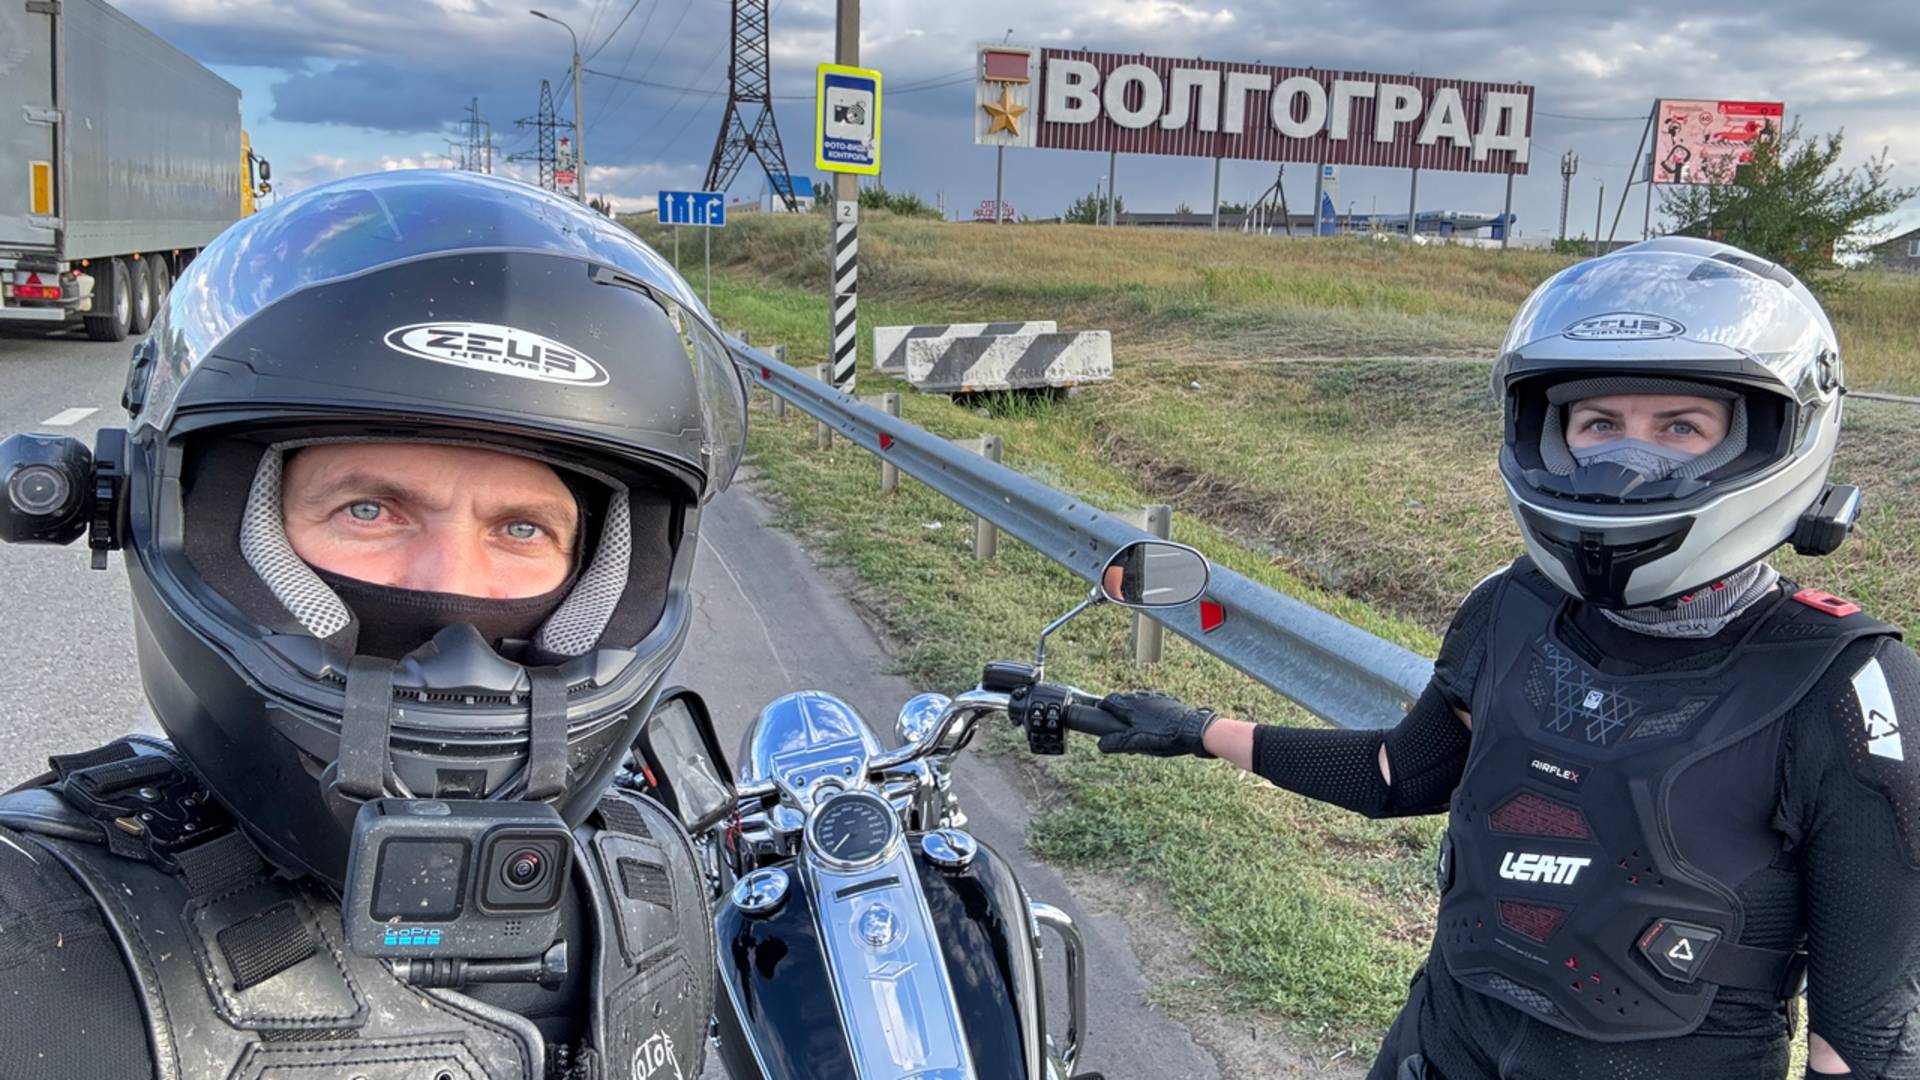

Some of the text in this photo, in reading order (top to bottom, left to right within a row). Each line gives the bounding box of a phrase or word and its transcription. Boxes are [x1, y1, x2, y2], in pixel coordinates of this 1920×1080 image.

[1046, 59, 1531, 163] ВОЛГОГРАД
[828, 150, 868, 161] КОНТРОЛЬ
[843, 206, 852, 217] 2
[426, 329, 576, 373] ZEUS
[450, 350, 554, 374] HELMET
[1531, 760, 1579, 783] AIRFLEX
[1499, 852, 1592, 885] LEATT
[385, 927, 441, 936] GoPro
